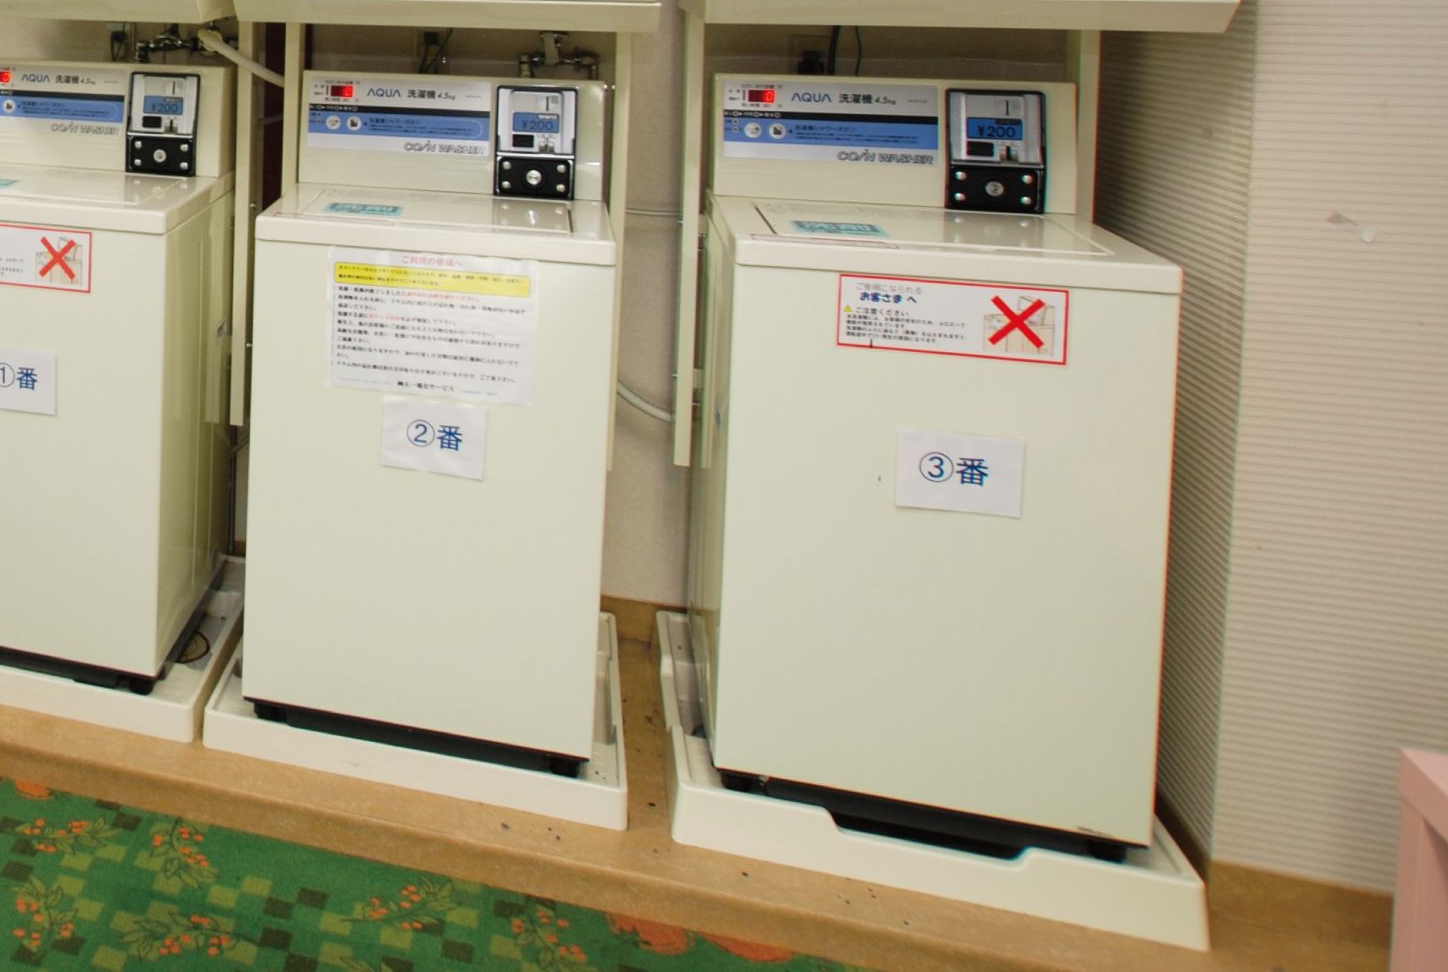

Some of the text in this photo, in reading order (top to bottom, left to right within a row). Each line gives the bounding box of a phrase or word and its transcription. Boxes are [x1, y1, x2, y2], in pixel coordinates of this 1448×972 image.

[21, 74, 50, 83] AQUA
[55, 75, 79, 85] 洗濯機
[366, 88, 402, 98] AQUA
[407, 89, 436, 99] 洗濯機
[764, 90, 775, 103] 0
[791, 92, 897, 106] AQUA 洗濯機 4.5kg
[977, 125, 1016, 138] ¥200
[438, 143, 485, 156] WASHER
[877, 153, 934, 165] WASHER
[859, 292, 903, 304] お客さま
